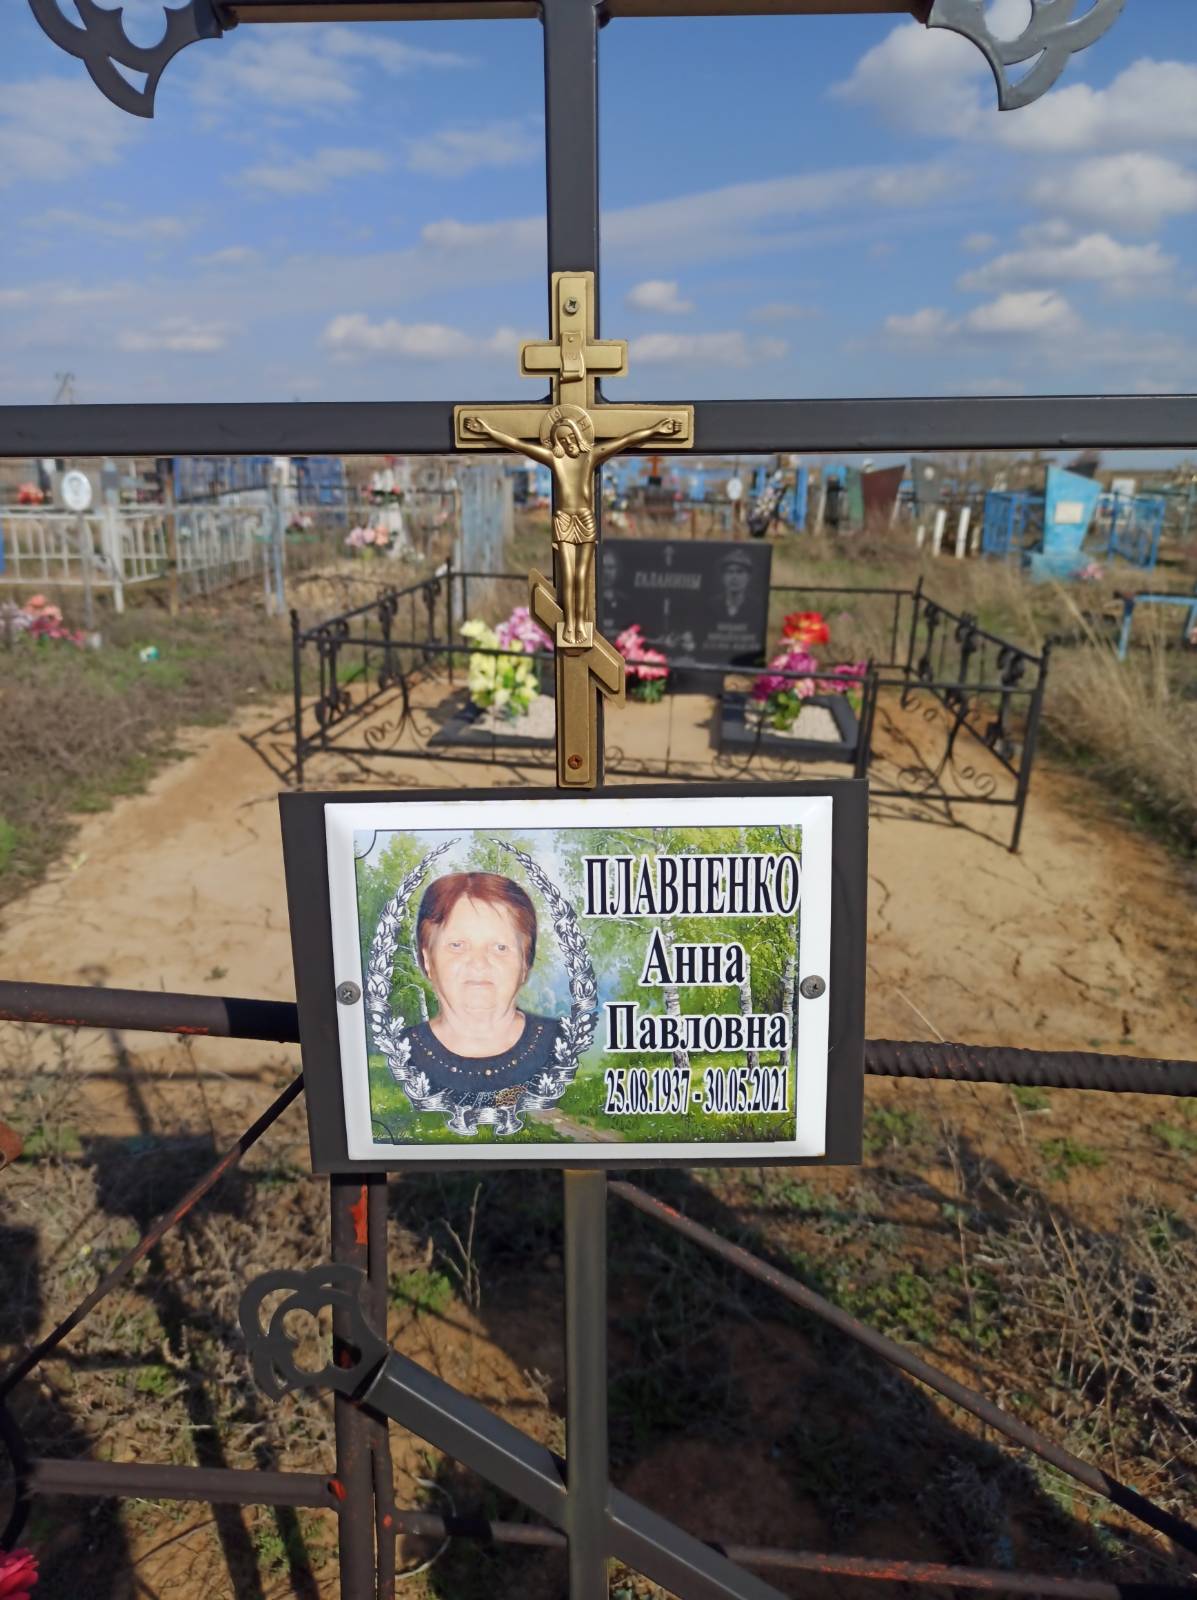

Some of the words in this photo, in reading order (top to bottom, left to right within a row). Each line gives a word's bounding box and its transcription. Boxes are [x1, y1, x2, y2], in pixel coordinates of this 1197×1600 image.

[584, 855, 799, 916] ПЛАВНЕНКО
[641, 929, 745, 984] Анна
[605, 1004, 788, 1050] Павловна
[606, 1068, 691, 1113] 25.08.1937
[704, 1067, 788, 1112] 30.05.2021
